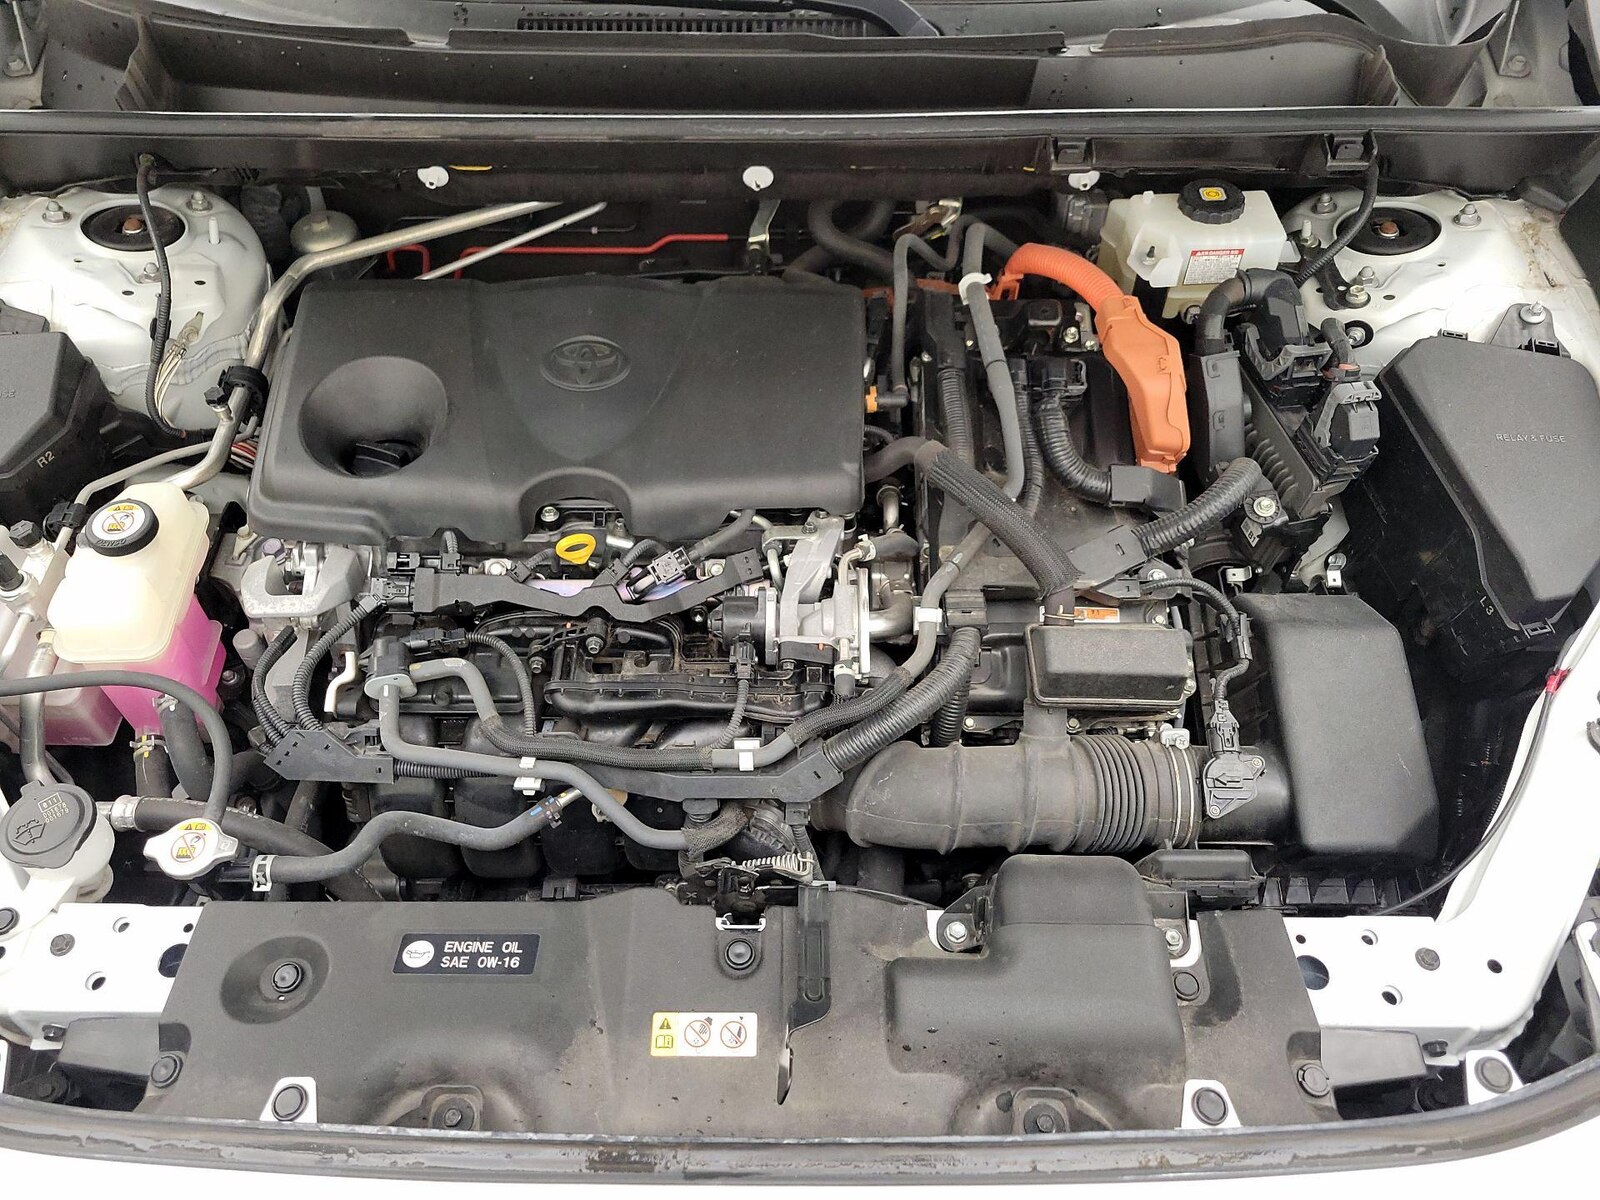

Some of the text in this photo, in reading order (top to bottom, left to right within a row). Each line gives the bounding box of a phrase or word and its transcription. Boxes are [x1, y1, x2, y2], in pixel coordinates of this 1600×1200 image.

[1495, 433, 1566, 443] RELAY & FUSE
[36, 450, 55, 468] R2
[443, 941, 523, 953] ENGINE OIL
[440, 956, 520, 968] SAE 0W-16
